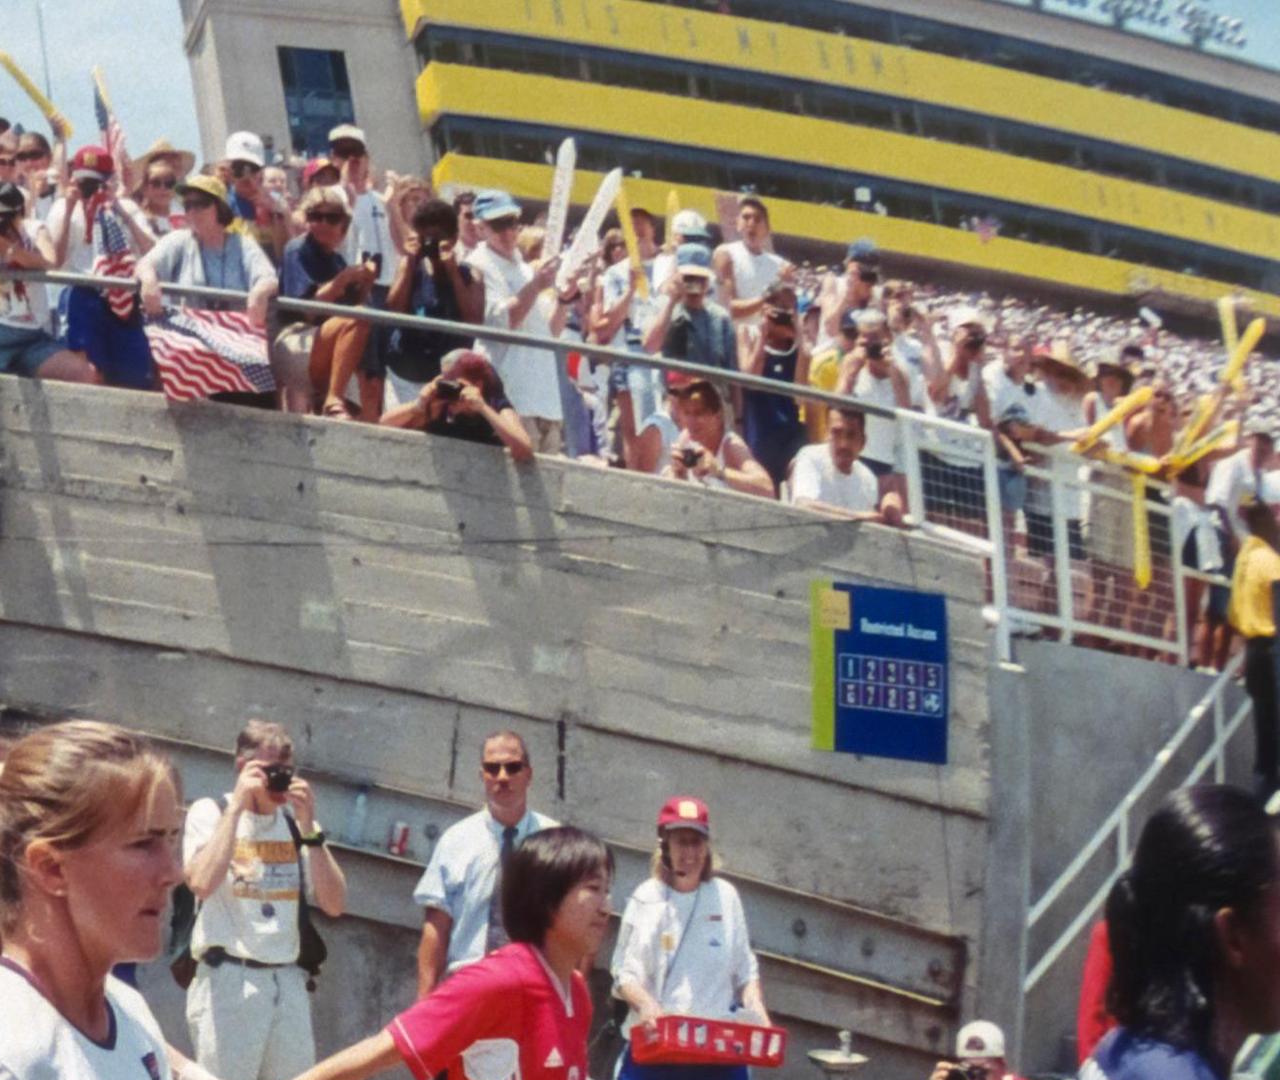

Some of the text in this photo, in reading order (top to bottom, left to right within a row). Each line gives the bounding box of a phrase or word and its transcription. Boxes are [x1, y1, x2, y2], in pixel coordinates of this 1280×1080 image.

[866, 661, 876, 681] 2
[906, 665, 916, 685] 4
[926, 667, 937, 688] 5
[866, 686, 876, 706] 7
